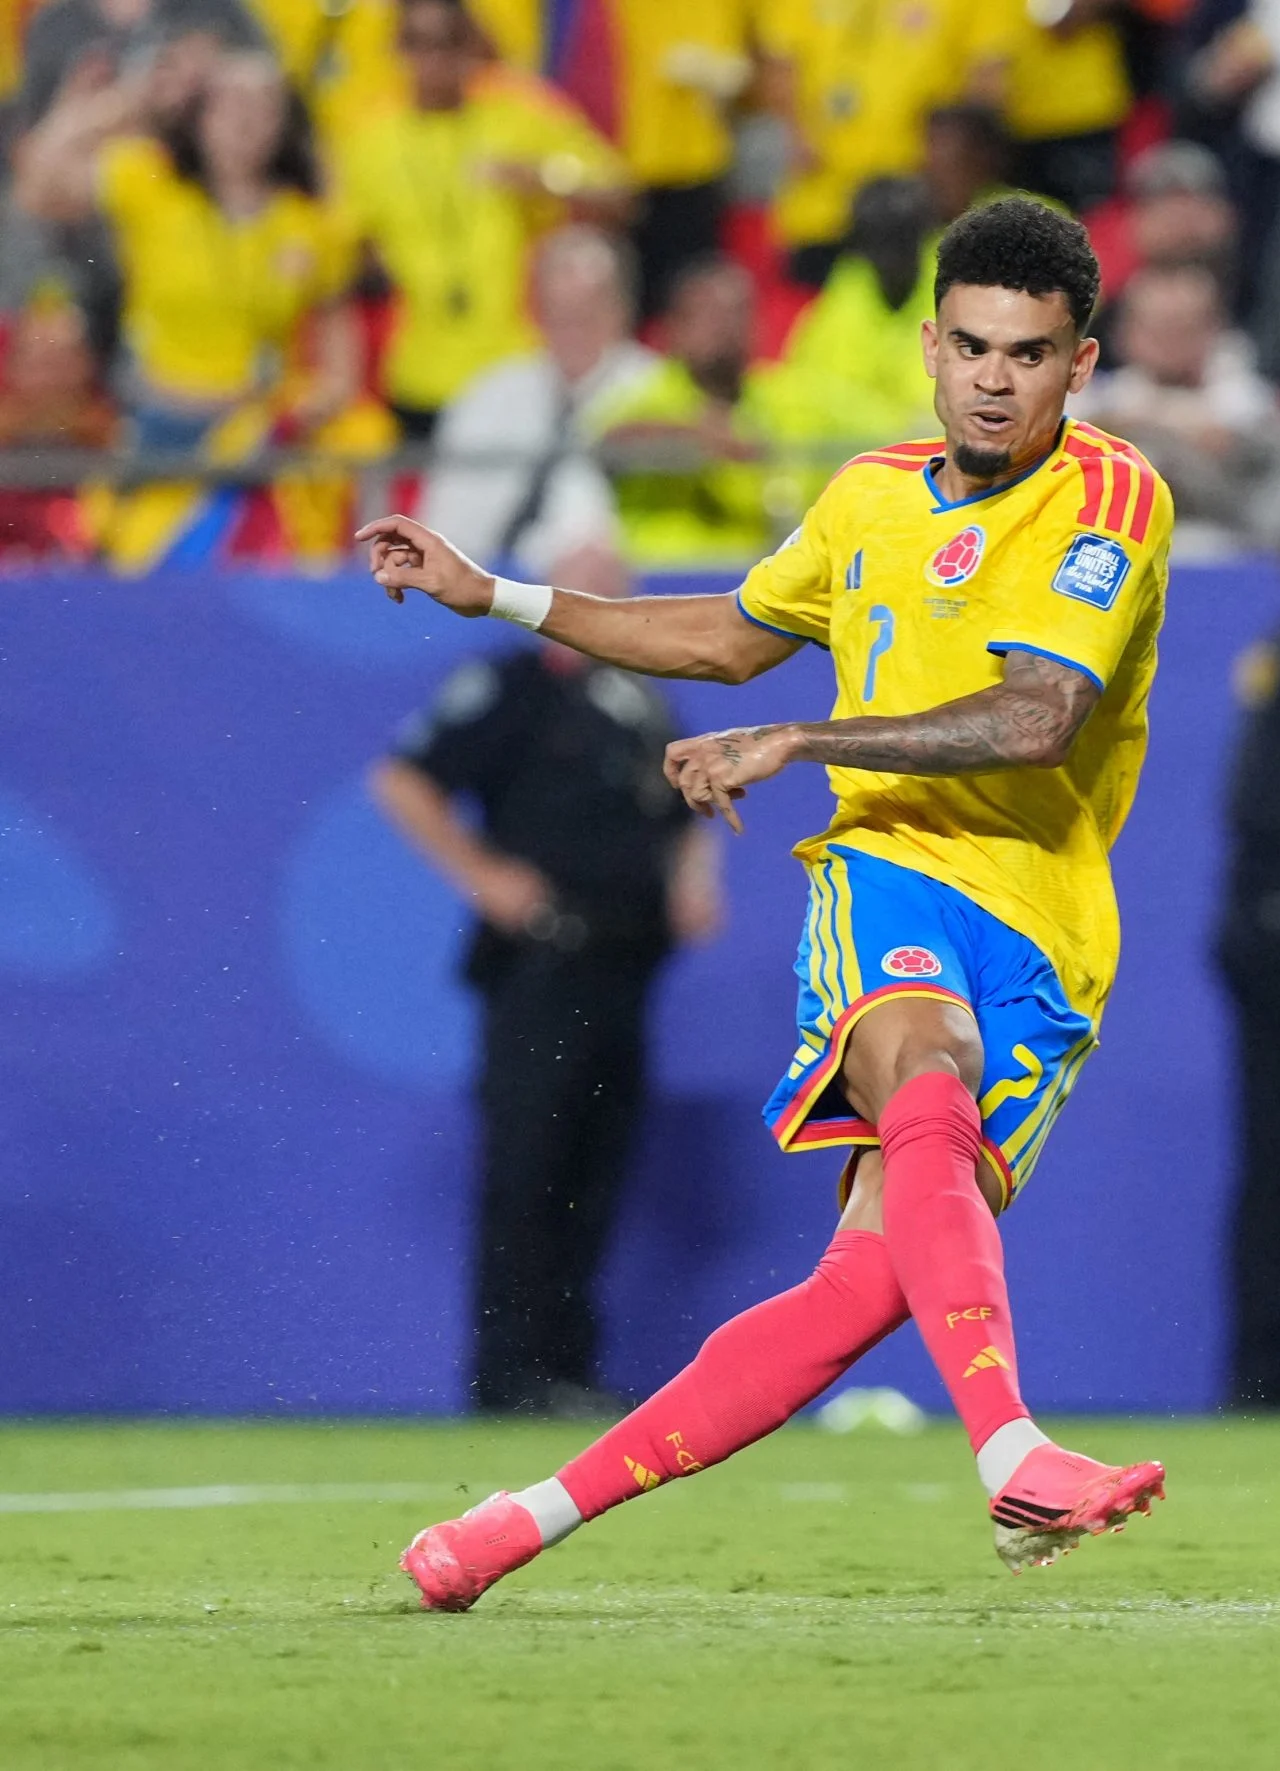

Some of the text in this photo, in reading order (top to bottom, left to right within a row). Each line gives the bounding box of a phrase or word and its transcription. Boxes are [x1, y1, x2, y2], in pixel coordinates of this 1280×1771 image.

[1074, 552, 1117, 578] UNITES
[863, 604, 894, 702] 7
[946, 1306, 993, 1329] FCF
